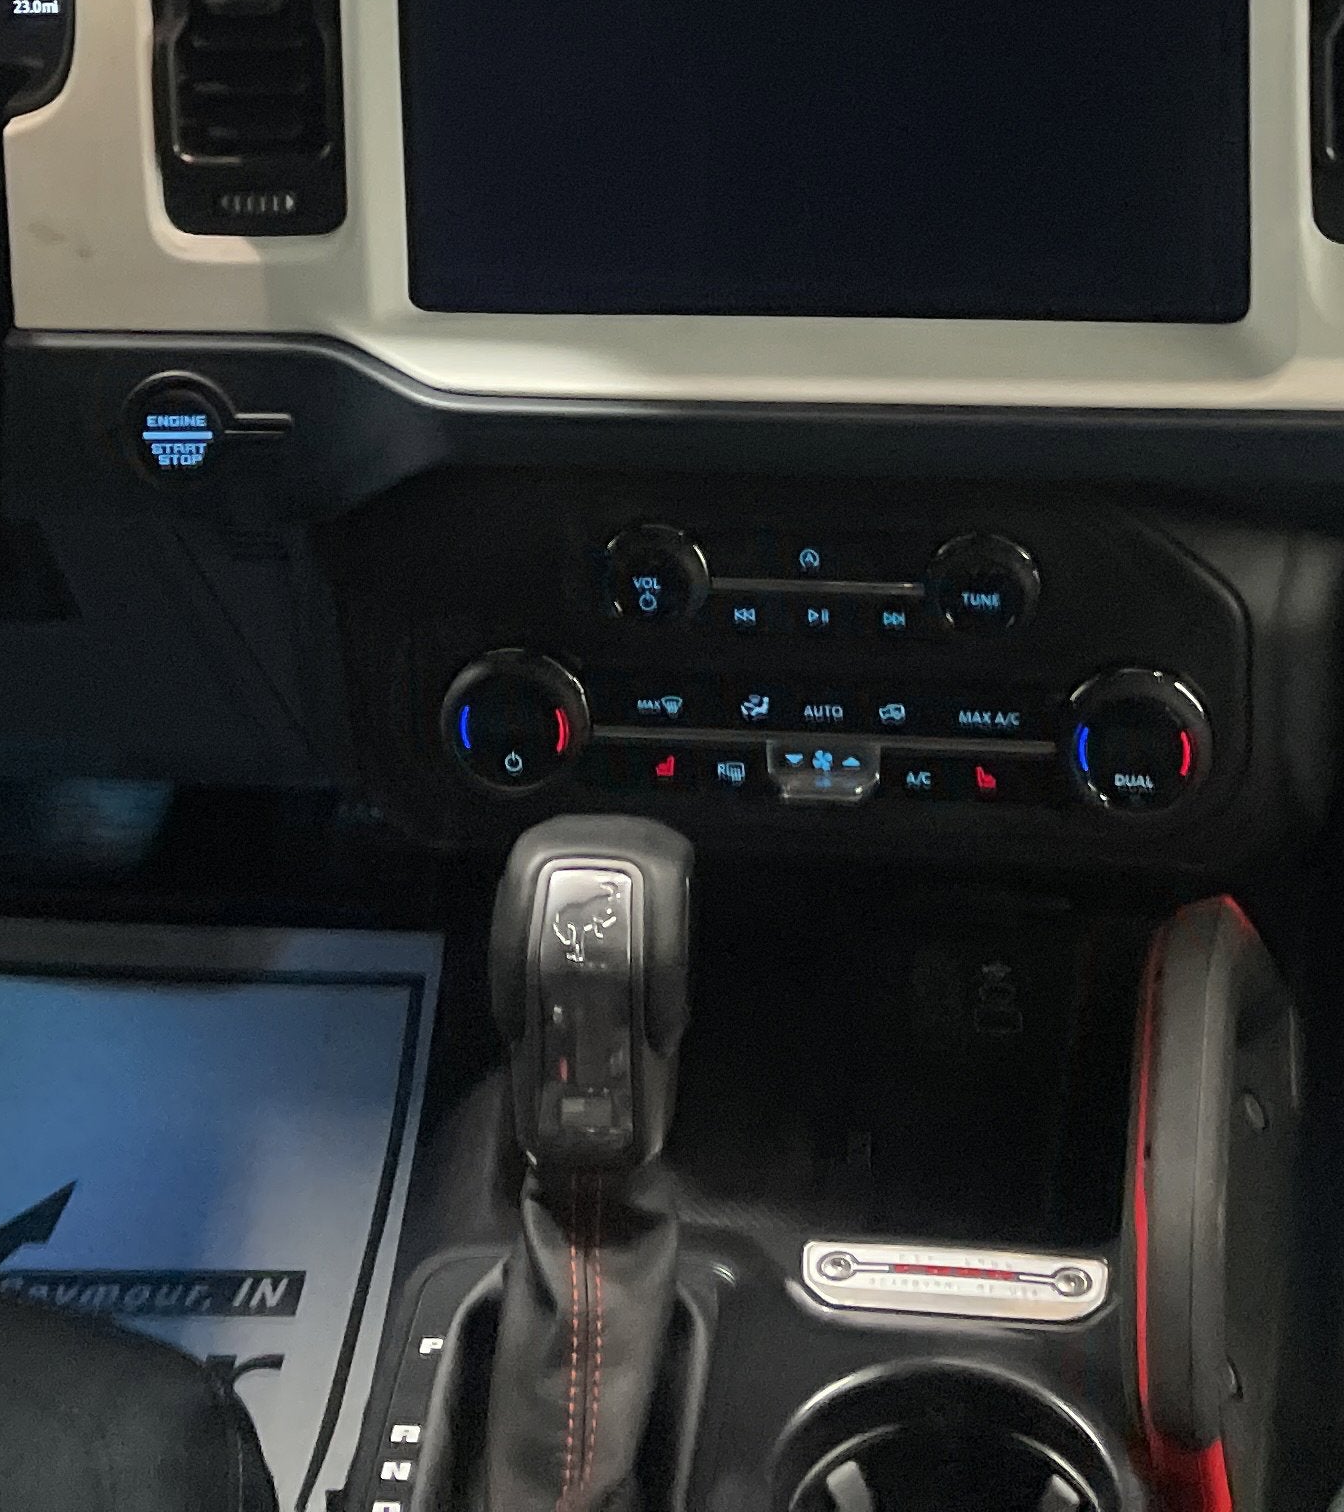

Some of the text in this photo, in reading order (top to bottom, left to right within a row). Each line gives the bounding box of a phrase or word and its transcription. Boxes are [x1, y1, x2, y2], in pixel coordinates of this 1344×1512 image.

[146, 415, 206, 427] ENGINE
[151, 443, 206, 455] START
[158, 454, 202, 465] STOP
[633, 577, 661, 590] VOL
[962, 592, 999, 607] TUNE
[804, 704, 843, 718] AUTO
[959, 710, 1020, 726] MAX A/C
[906, 772, 931, 785] A/C
[1114, 773, 1154, 789] DUAL
[232, 1277, 289, 1307] IN
[419, 1338, 444, 1354] P
[380, 1461, 412, 1480] N
